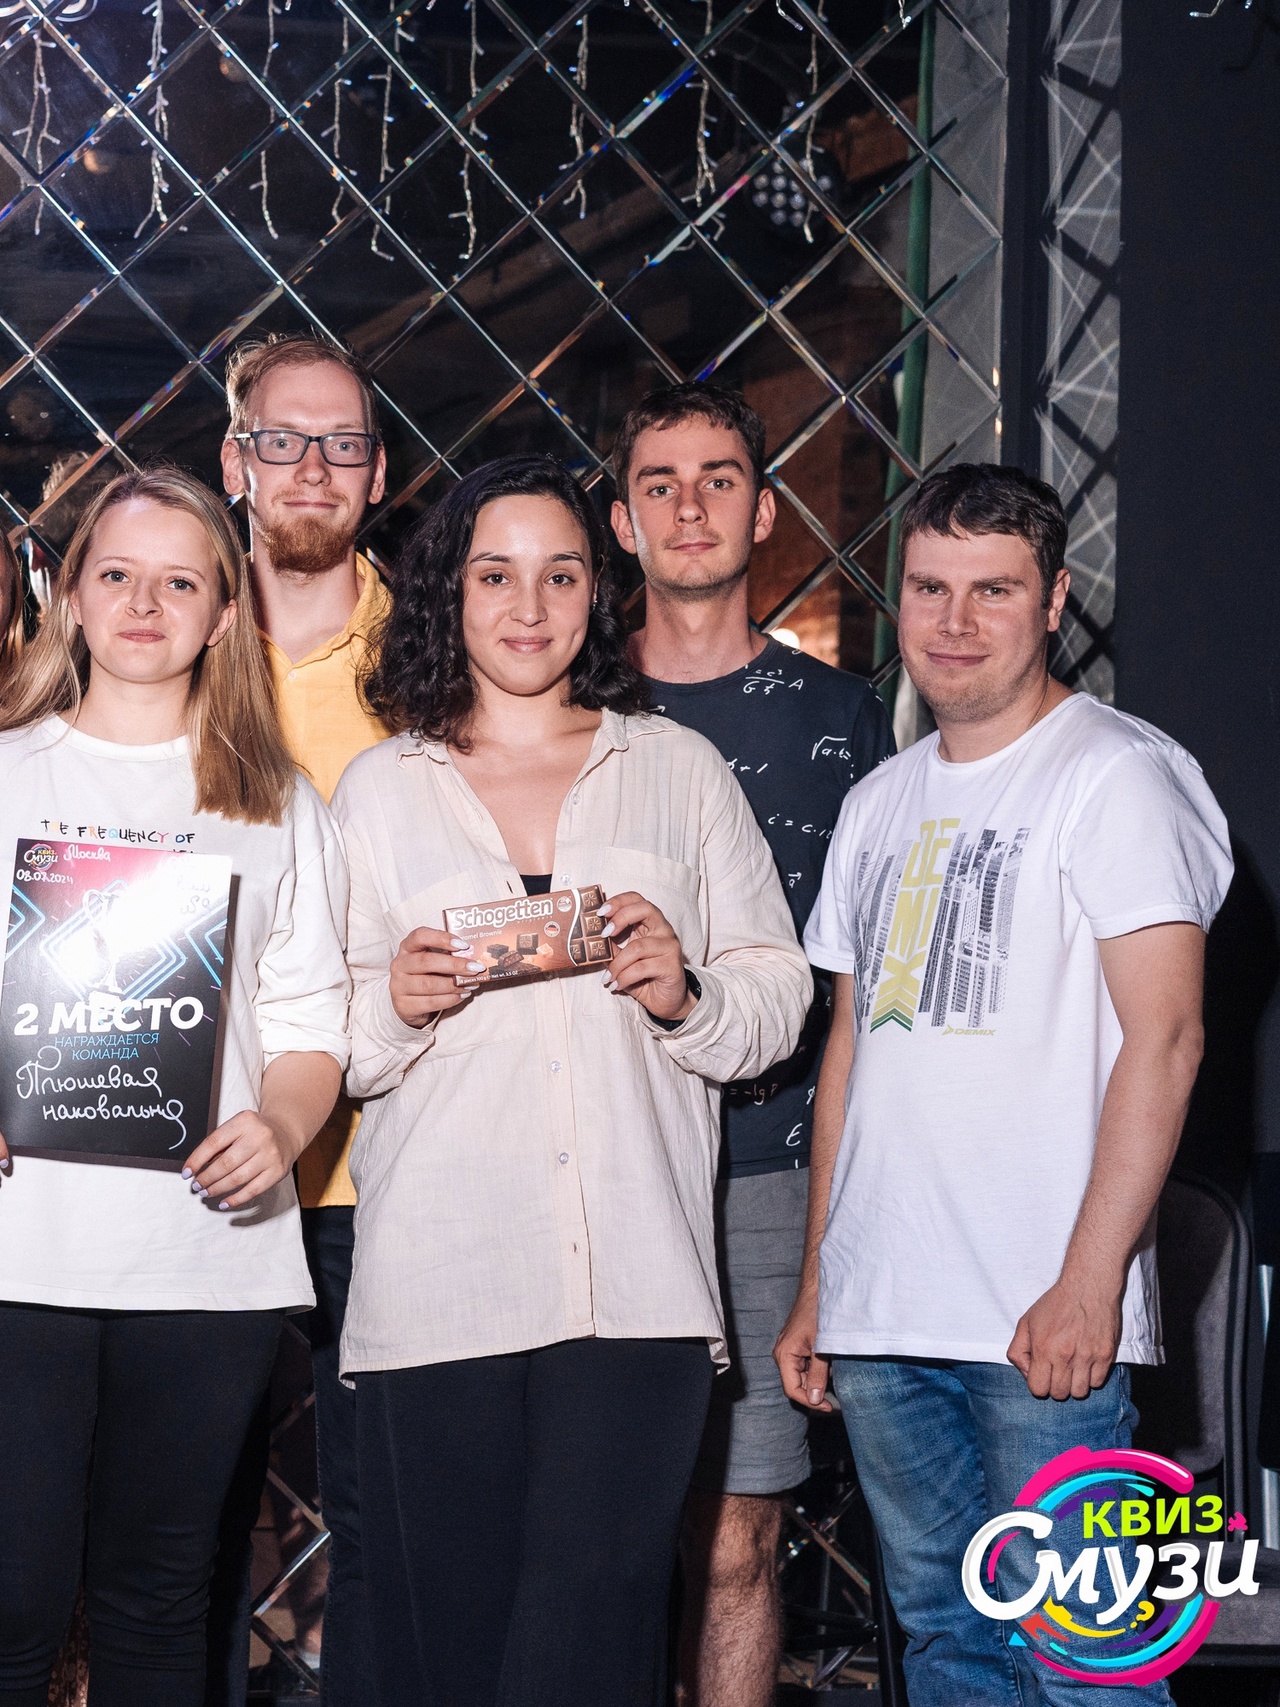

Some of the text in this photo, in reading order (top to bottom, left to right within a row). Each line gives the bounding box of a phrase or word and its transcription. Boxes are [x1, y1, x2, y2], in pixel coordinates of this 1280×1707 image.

[41, 819, 195, 844] THE FREQUENCY OF
[23, 850, 59, 864] Смузи
[63, 844, 111, 862] Москва
[452, 898, 554, 929] Schogetten
[479, 929, 503, 938] Brownie
[14, 996, 204, 1036] 2 МЕСТО
[55, 1032, 160, 1048] НАГРАЖДАЕТСЯ
[954, 1028, 997, 1036] DEMIX
[72, 1047, 140, 1061] КОМАНДА
[16, 1045, 162, 1099] Плюшевая
[43, 1094, 187, 1150] наковальня
